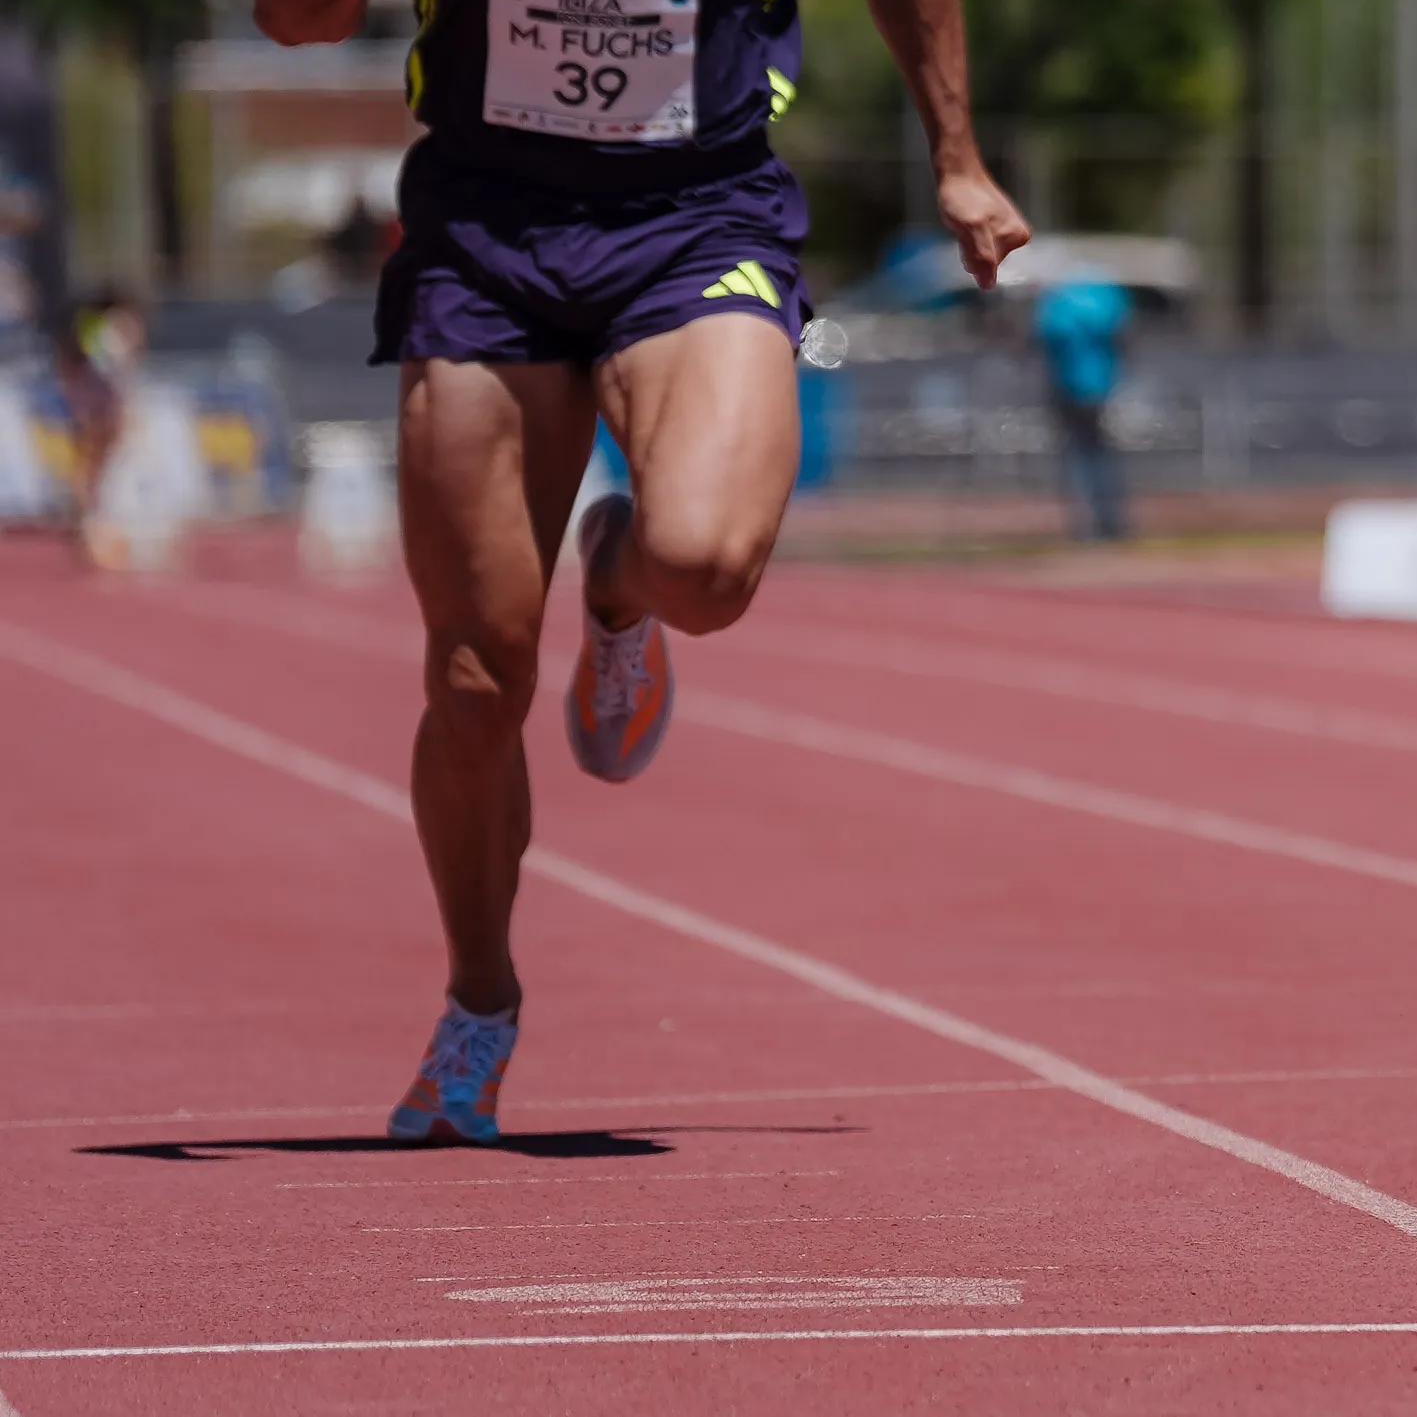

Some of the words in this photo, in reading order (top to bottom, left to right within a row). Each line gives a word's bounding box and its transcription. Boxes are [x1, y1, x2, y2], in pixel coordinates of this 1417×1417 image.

[508, 22, 547, 51] M.
[561, 29, 674, 59] FUCHS
[552, 60, 628, 112] 39
